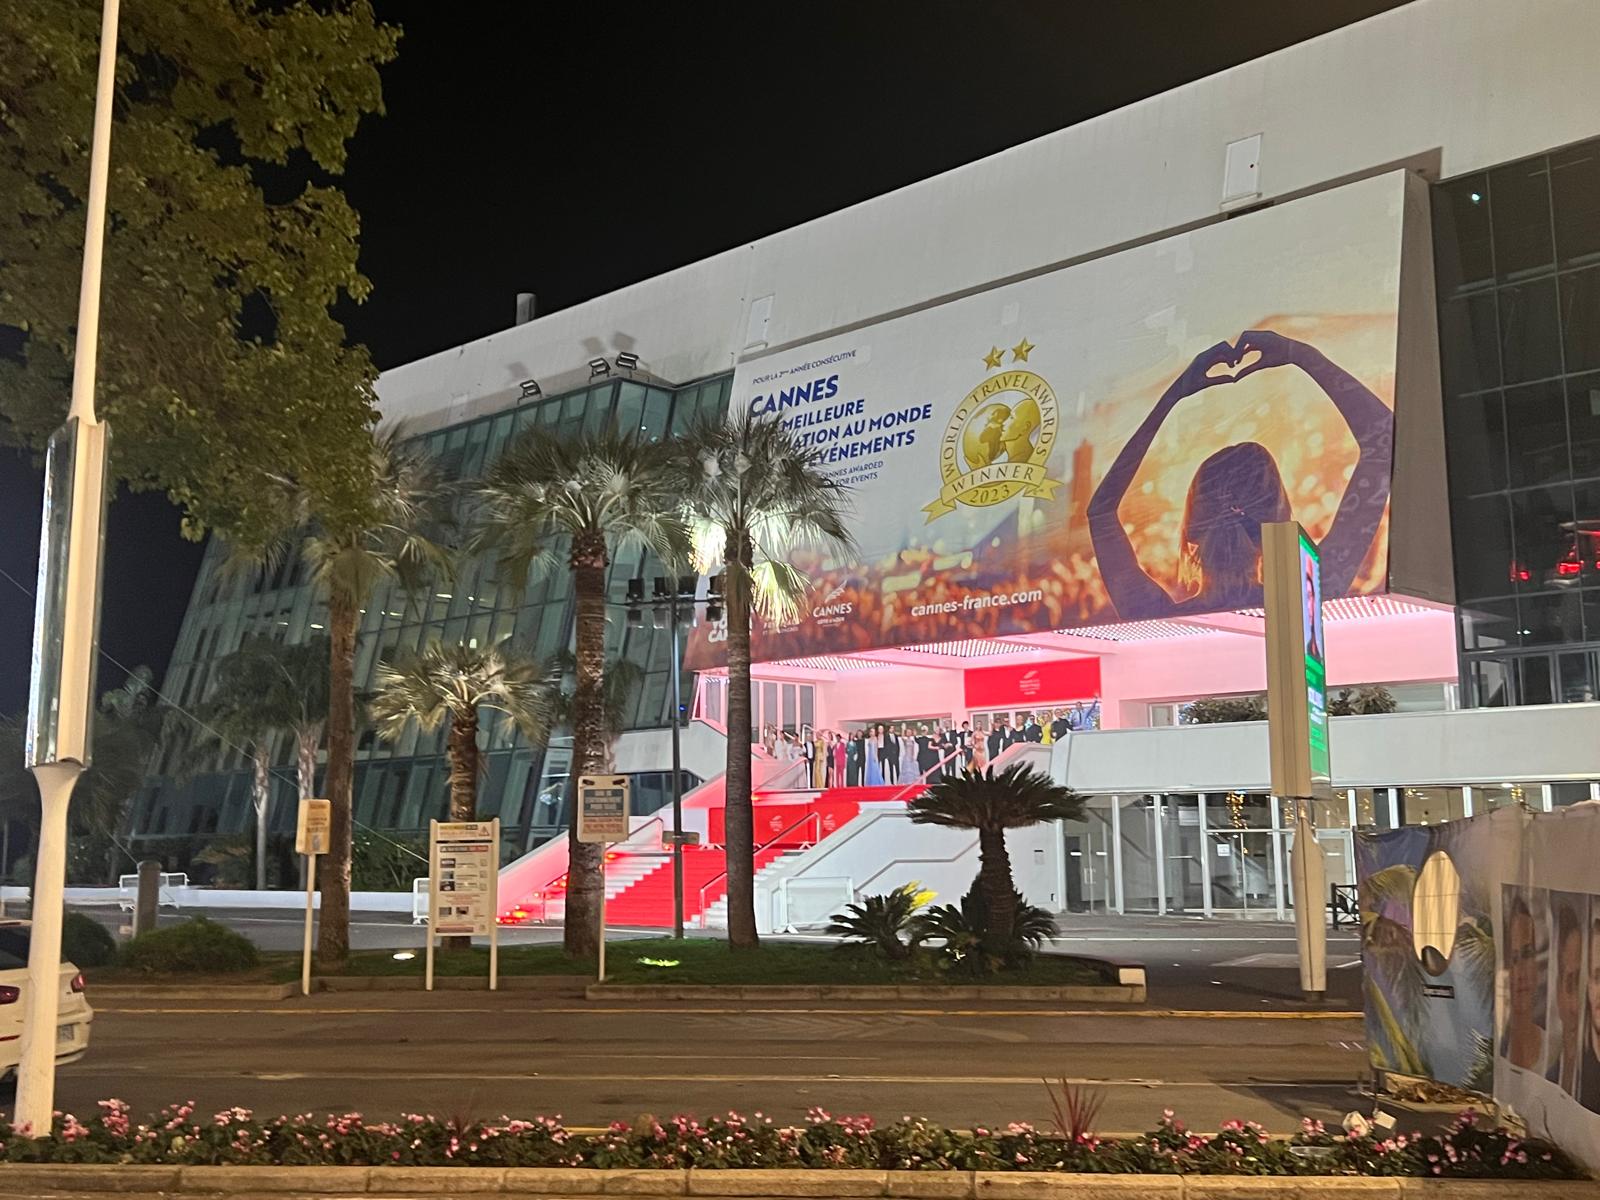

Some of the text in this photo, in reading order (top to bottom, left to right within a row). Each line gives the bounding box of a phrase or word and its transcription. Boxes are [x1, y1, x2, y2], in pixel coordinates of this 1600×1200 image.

[811, 349, 857, 369] CONSÉCUTIVE
[750, 375, 839, 418] CANNES
[782, 399, 865, 432] MEILLEURE
[792, 403, 932, 449] ATION AU MONDE
[943, 375, 1055, 479] WORLD TRAVEL AWARDS
[848, 460, 884, 475] AWARDED
[850, 472, 878, 484] EVENTS
[951, 465, 1034, 494] WINNER
[970, 484, 1010, 503] 2023
[813, 601, 853, 618] CANNES
[911, 590, 1042, 617] cannes-france.com
